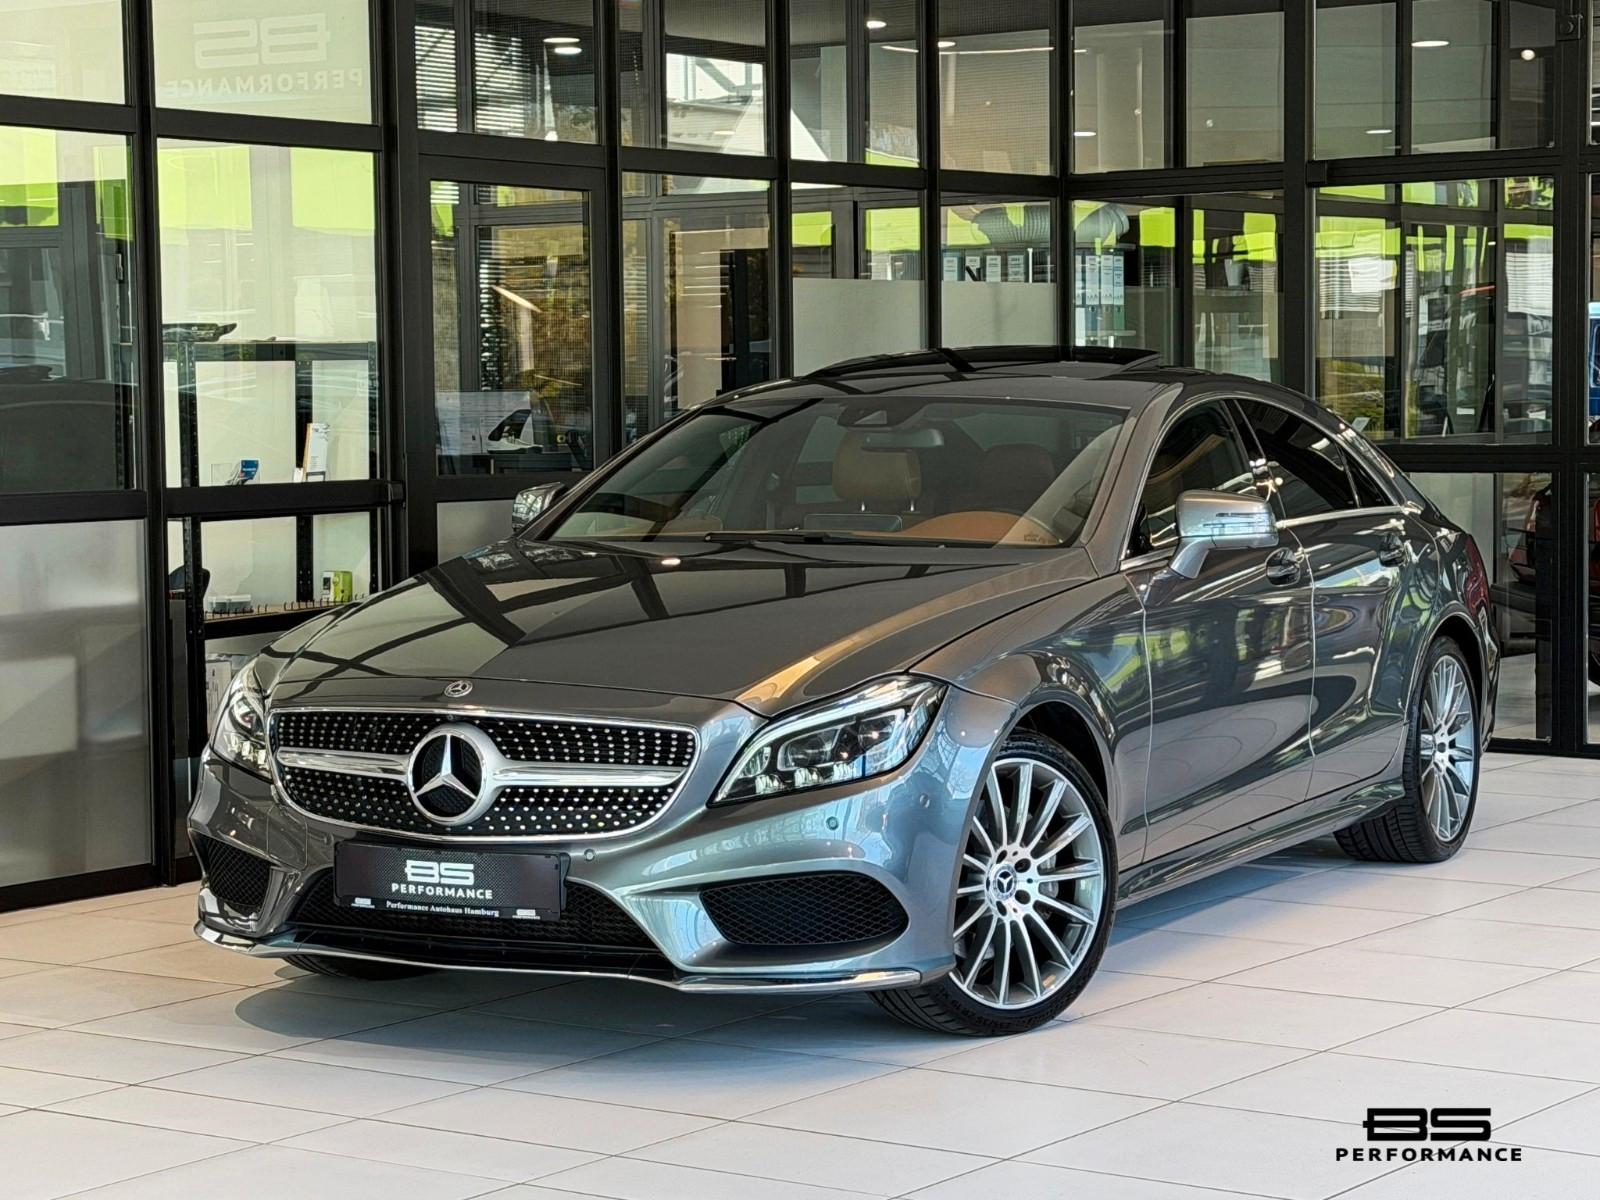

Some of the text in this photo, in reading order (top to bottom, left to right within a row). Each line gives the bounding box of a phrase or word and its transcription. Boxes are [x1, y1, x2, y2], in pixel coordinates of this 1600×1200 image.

[391, 883, 493, 900] PERFORMANCE
[386, 900, 429, 912] Performance
[430, 905, 463, 914] Autohaus
[464, 907, 500, 918] Hamburg
